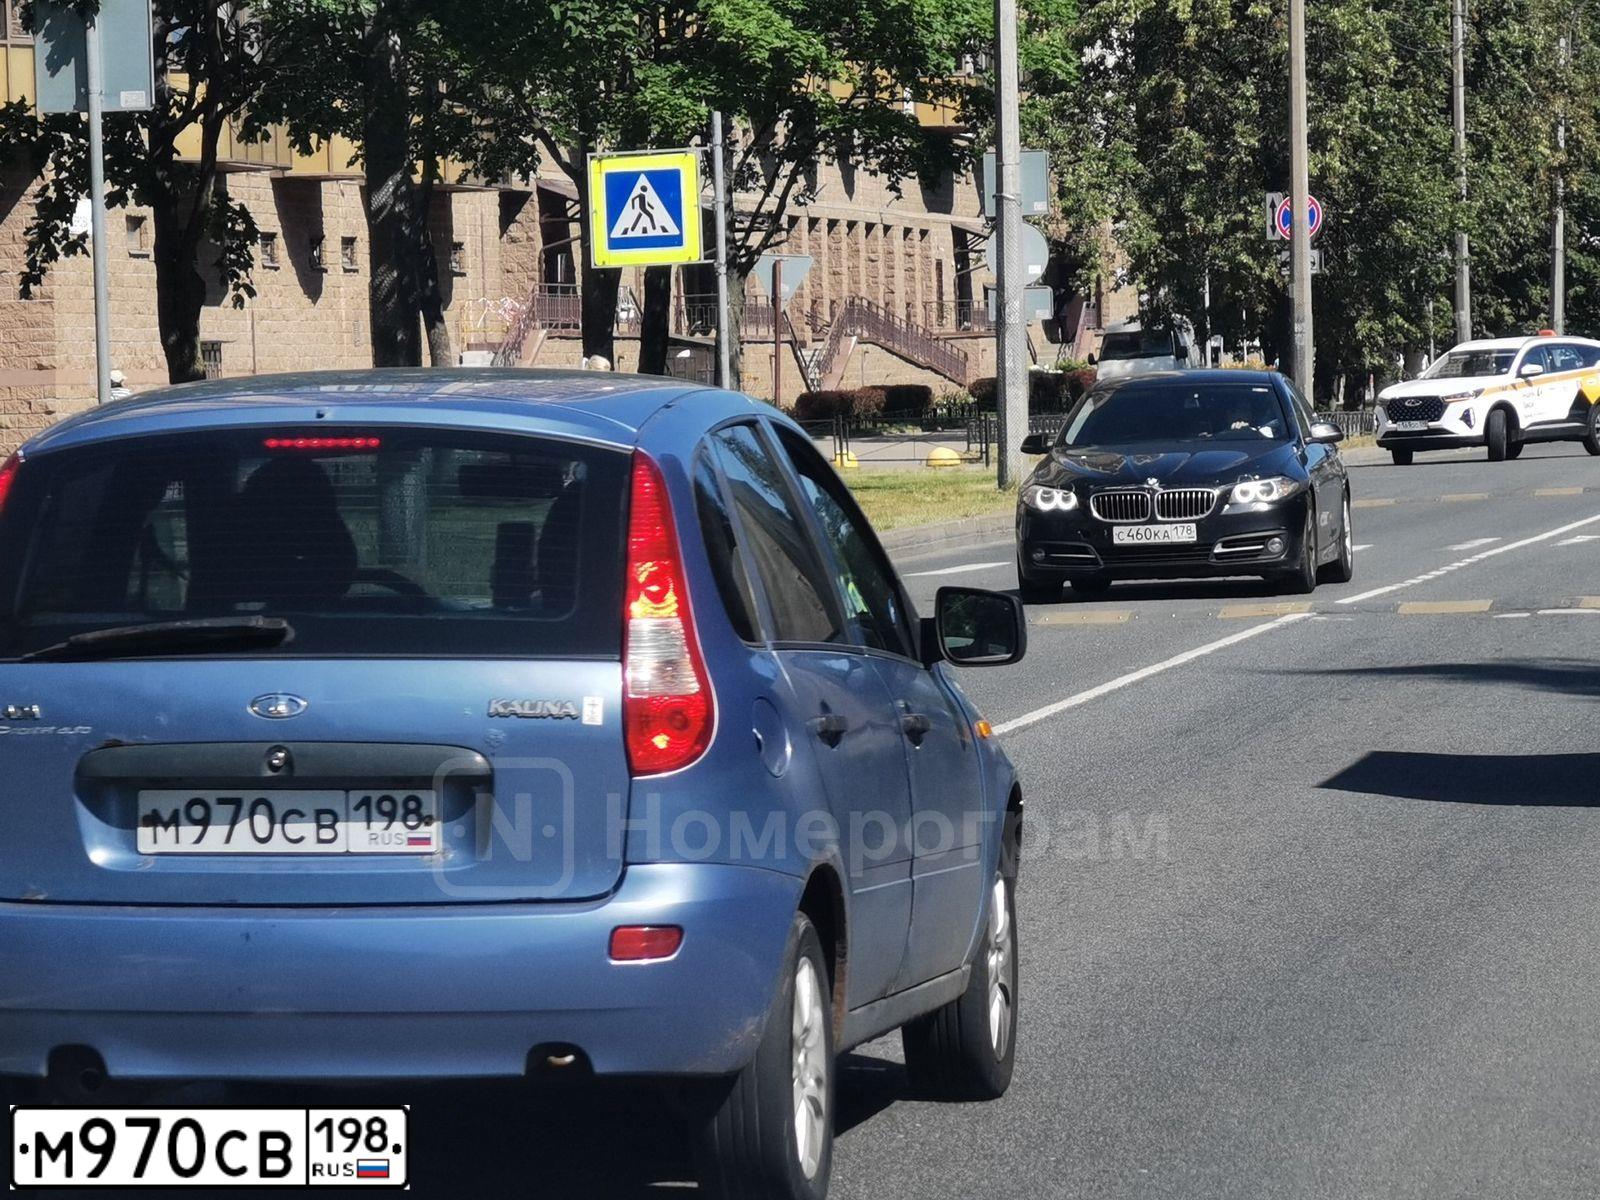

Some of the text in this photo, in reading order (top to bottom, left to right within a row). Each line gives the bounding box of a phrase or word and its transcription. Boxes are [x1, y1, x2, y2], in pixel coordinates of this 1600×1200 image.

[1117, 524, 1192, 541] С460КА 178
[487, 698, 580, 719] KALINA
[152, 794, 424, 845] М970СВ 198
[368, 832, 405, 846] RUS
